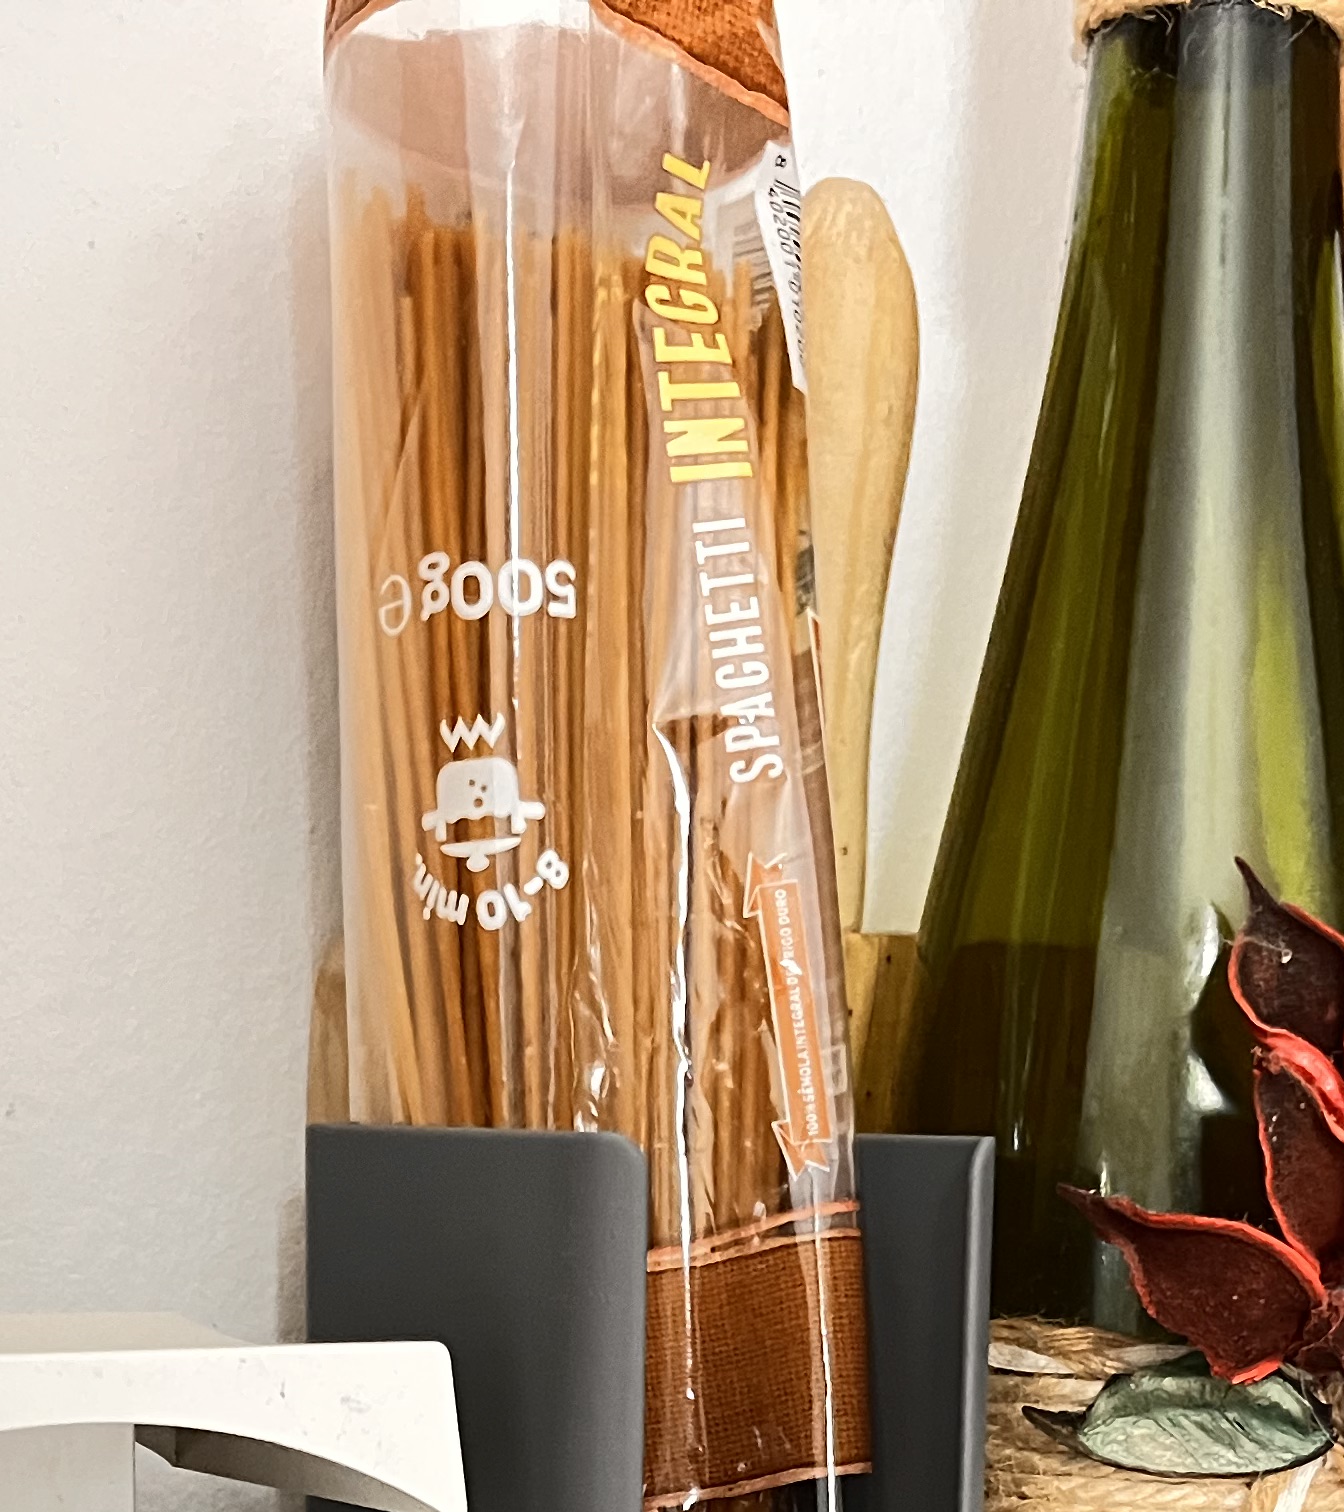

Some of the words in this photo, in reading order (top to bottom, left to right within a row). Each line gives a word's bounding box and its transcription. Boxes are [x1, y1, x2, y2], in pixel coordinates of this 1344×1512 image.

[646, 151, 754, 486] INTEGRAL
[417, 551, 577, 622] 500g
[692, 516, 784, 785] SPAGHETTI
[475, 849, 570, 932] 8-10
